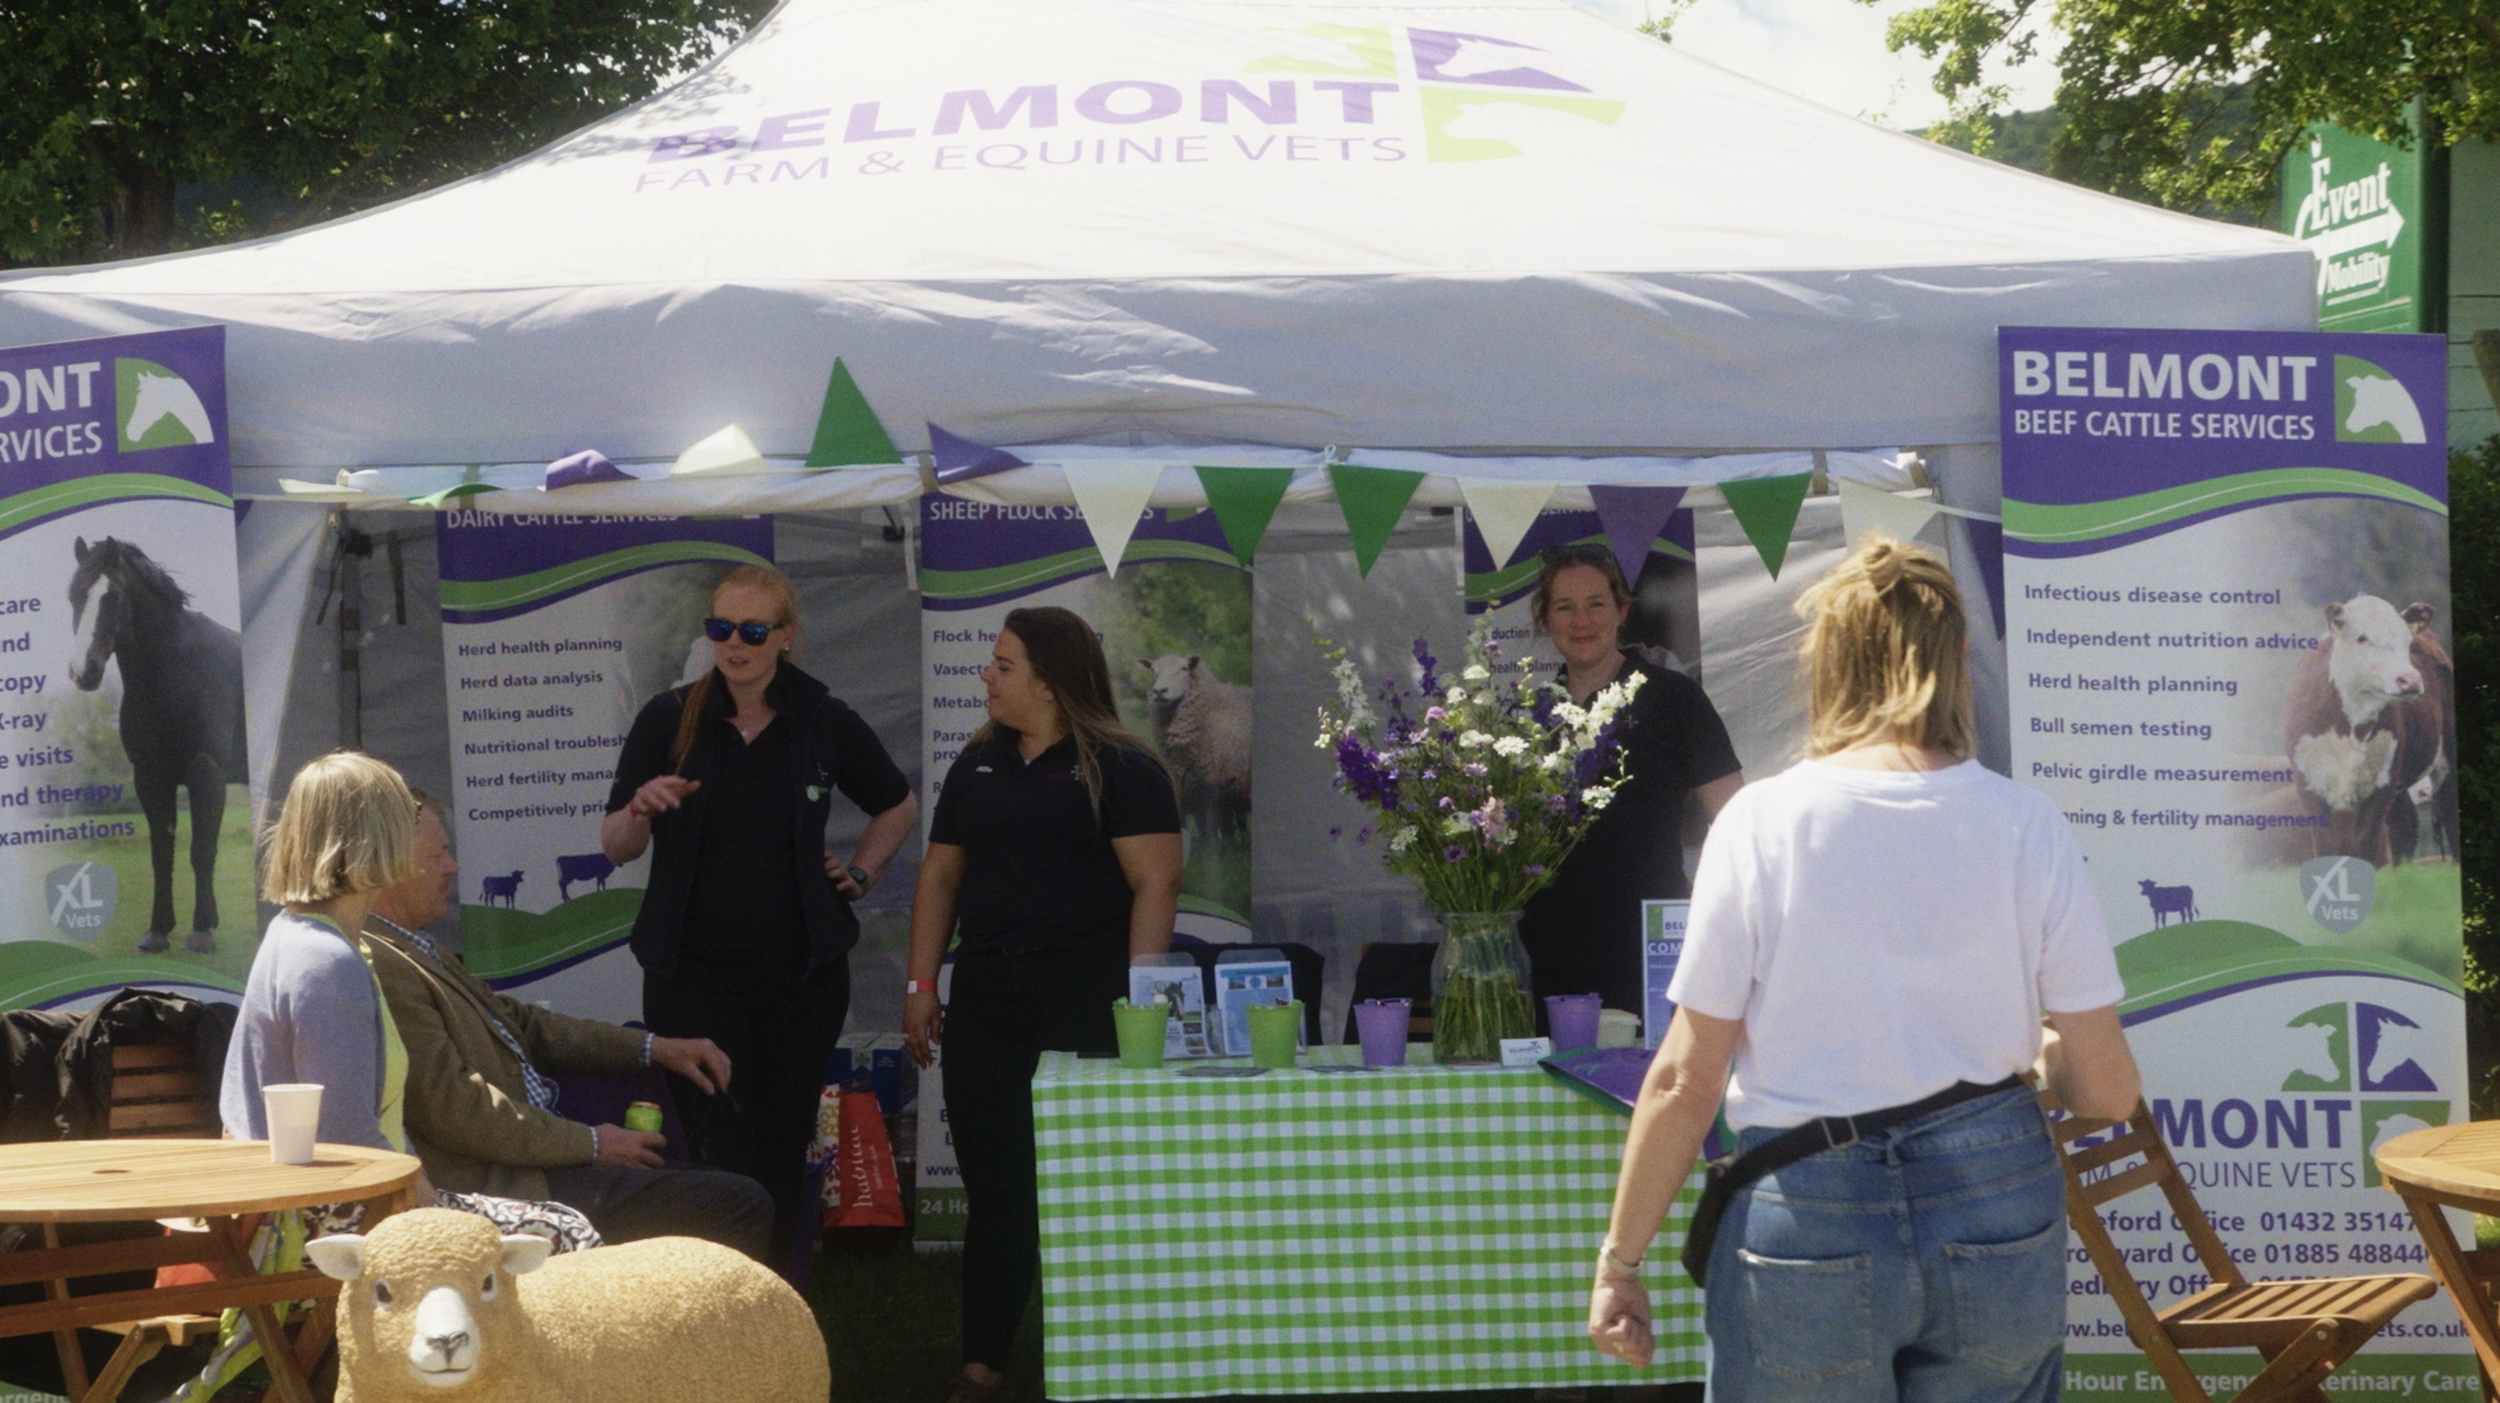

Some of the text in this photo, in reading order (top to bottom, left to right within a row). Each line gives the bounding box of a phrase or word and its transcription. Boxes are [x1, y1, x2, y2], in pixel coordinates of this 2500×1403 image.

[646, 80, 1399, 164] BELMONT
[634, 134, 1407, 193] FARM & EQUINE VETS
[2309, 157, 2391, 231] Event
[2326, 252, 2391, 293] Mobility
[2013, 350, 2317, 402] BELMONT
[2014, 408, 2315, 441] BEEF CATTLE SERVICES
[930, 501, 990, 520] SHEEP
[997, 505, 1058, 520] FLOCK
[2025, 583, 2281, 605] Infectious disease control
[458, 637, 623, 657] Herd health planning
[933, 630, 973, 642] Flock
[2026, 628, 2319, 650] Independent nutrition advice
[460, 670, 603, 690] Herd data analysis
[2028, 672, 2239, 696] Herd health planning
[462, 705, 574, 723] Milking audits
[2030, 717, 2212, 741] Bull semen testing
[16, 745, 74, 768] visits
[464, 738, 550, 756] Nutritional
[466, 774, 504, 788] Herd
[509, 770, 568, 788] fertility
[2032, 761, 2294, 784] Pelvic girdle measurement
[36, 782, 124, 806] therapy
[469, 802, 577, 822] Competitively
[2113, 809, 2126, 826] &
[2131, 808, 2200, 830] fertility
[2205, 812, 2329, 831] management
[51, 861, 104, 927] XL
[2306, 856, 2361, 915] XL
[65, 913, 102, 929] Vets
[2321, 904, 2359, 921] Vets
[2176, 1161, 2356, 1191] QUINE VETS
[921, 1200, 943, 1214] 24
[2260, 1212, 2336, 1232] 01432
[2344, 1212, 2416, 1232] 35147
[2265, 1243, 2340, 1264] 01885
[2348, 1243, 2429, 1264] 48844
[2065, 1370, 2128, 1391] Hour
[2423, 1370, 2480, 1391] Care
